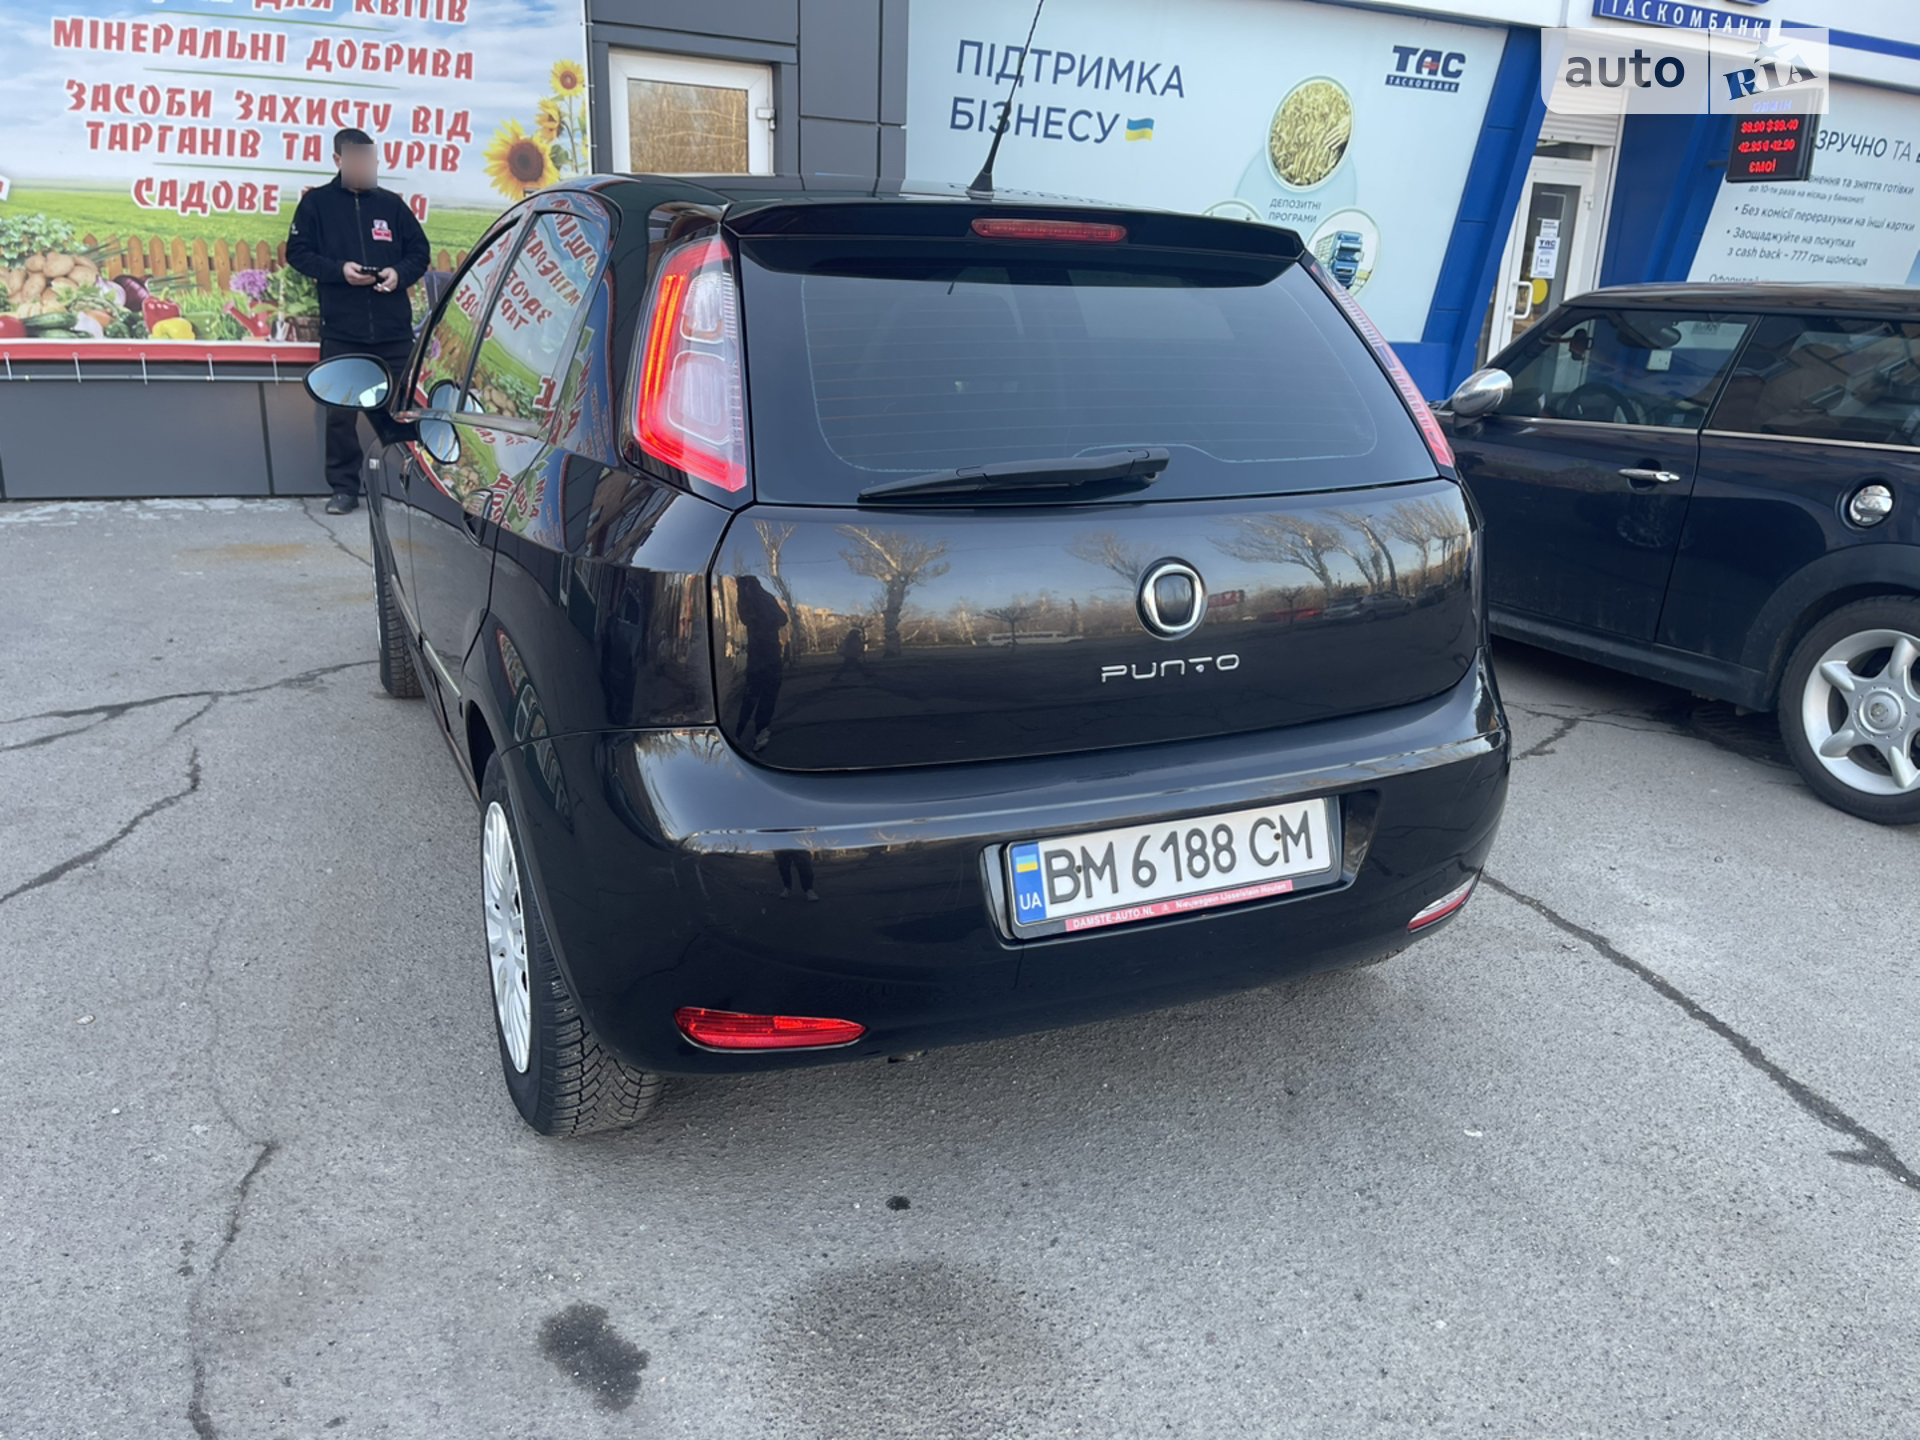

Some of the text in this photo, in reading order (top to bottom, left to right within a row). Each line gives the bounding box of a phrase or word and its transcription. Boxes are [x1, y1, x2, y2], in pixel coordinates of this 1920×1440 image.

[53, 18, 474, 80] МІНЕРАЛЬНІ ДОБРИВА
[1392, 45, 1467, 79] ТАС
[956, 40, 1185, 98] ПІДТРИМКА
[66, 80, 472, 142] ЗАСОБИ ЗАХИСТУ ВІД
[949, 96, 1120, 143] БІЗНЕСУ
[87, 120, 461, 172] ТАРГАНІВ ТА УРІВ
[1815, 130, 1888, 158] ЗРУЧНО
[1893, 140, 1911, 161] ТА
[132, 177, 280, 214] САДОВЕ
[1808, 175, 1841, 186] внення
[1842, 178, 1852, 188] та
[1268, 211, 1317, 223] ПРОГРАМИ
[1269, 198, 1322, 210] ДЕПОЗИТНІ
[1741, 204, 1915, 232] Без комісії перерахунки на інші картки
[1733, 227, 1857, 248] Заощаджуйте на покупках
[1735, 246, 1757, 258] cash
[1759, 248, 1782, 260] back
[1790, 250, 1808, 262] 777
[1101, 653, 1241, 683] PUNTO
[1045, 810, 1313, 905] BM 6188 CM
[1019, 892, 1043, 911] UA
